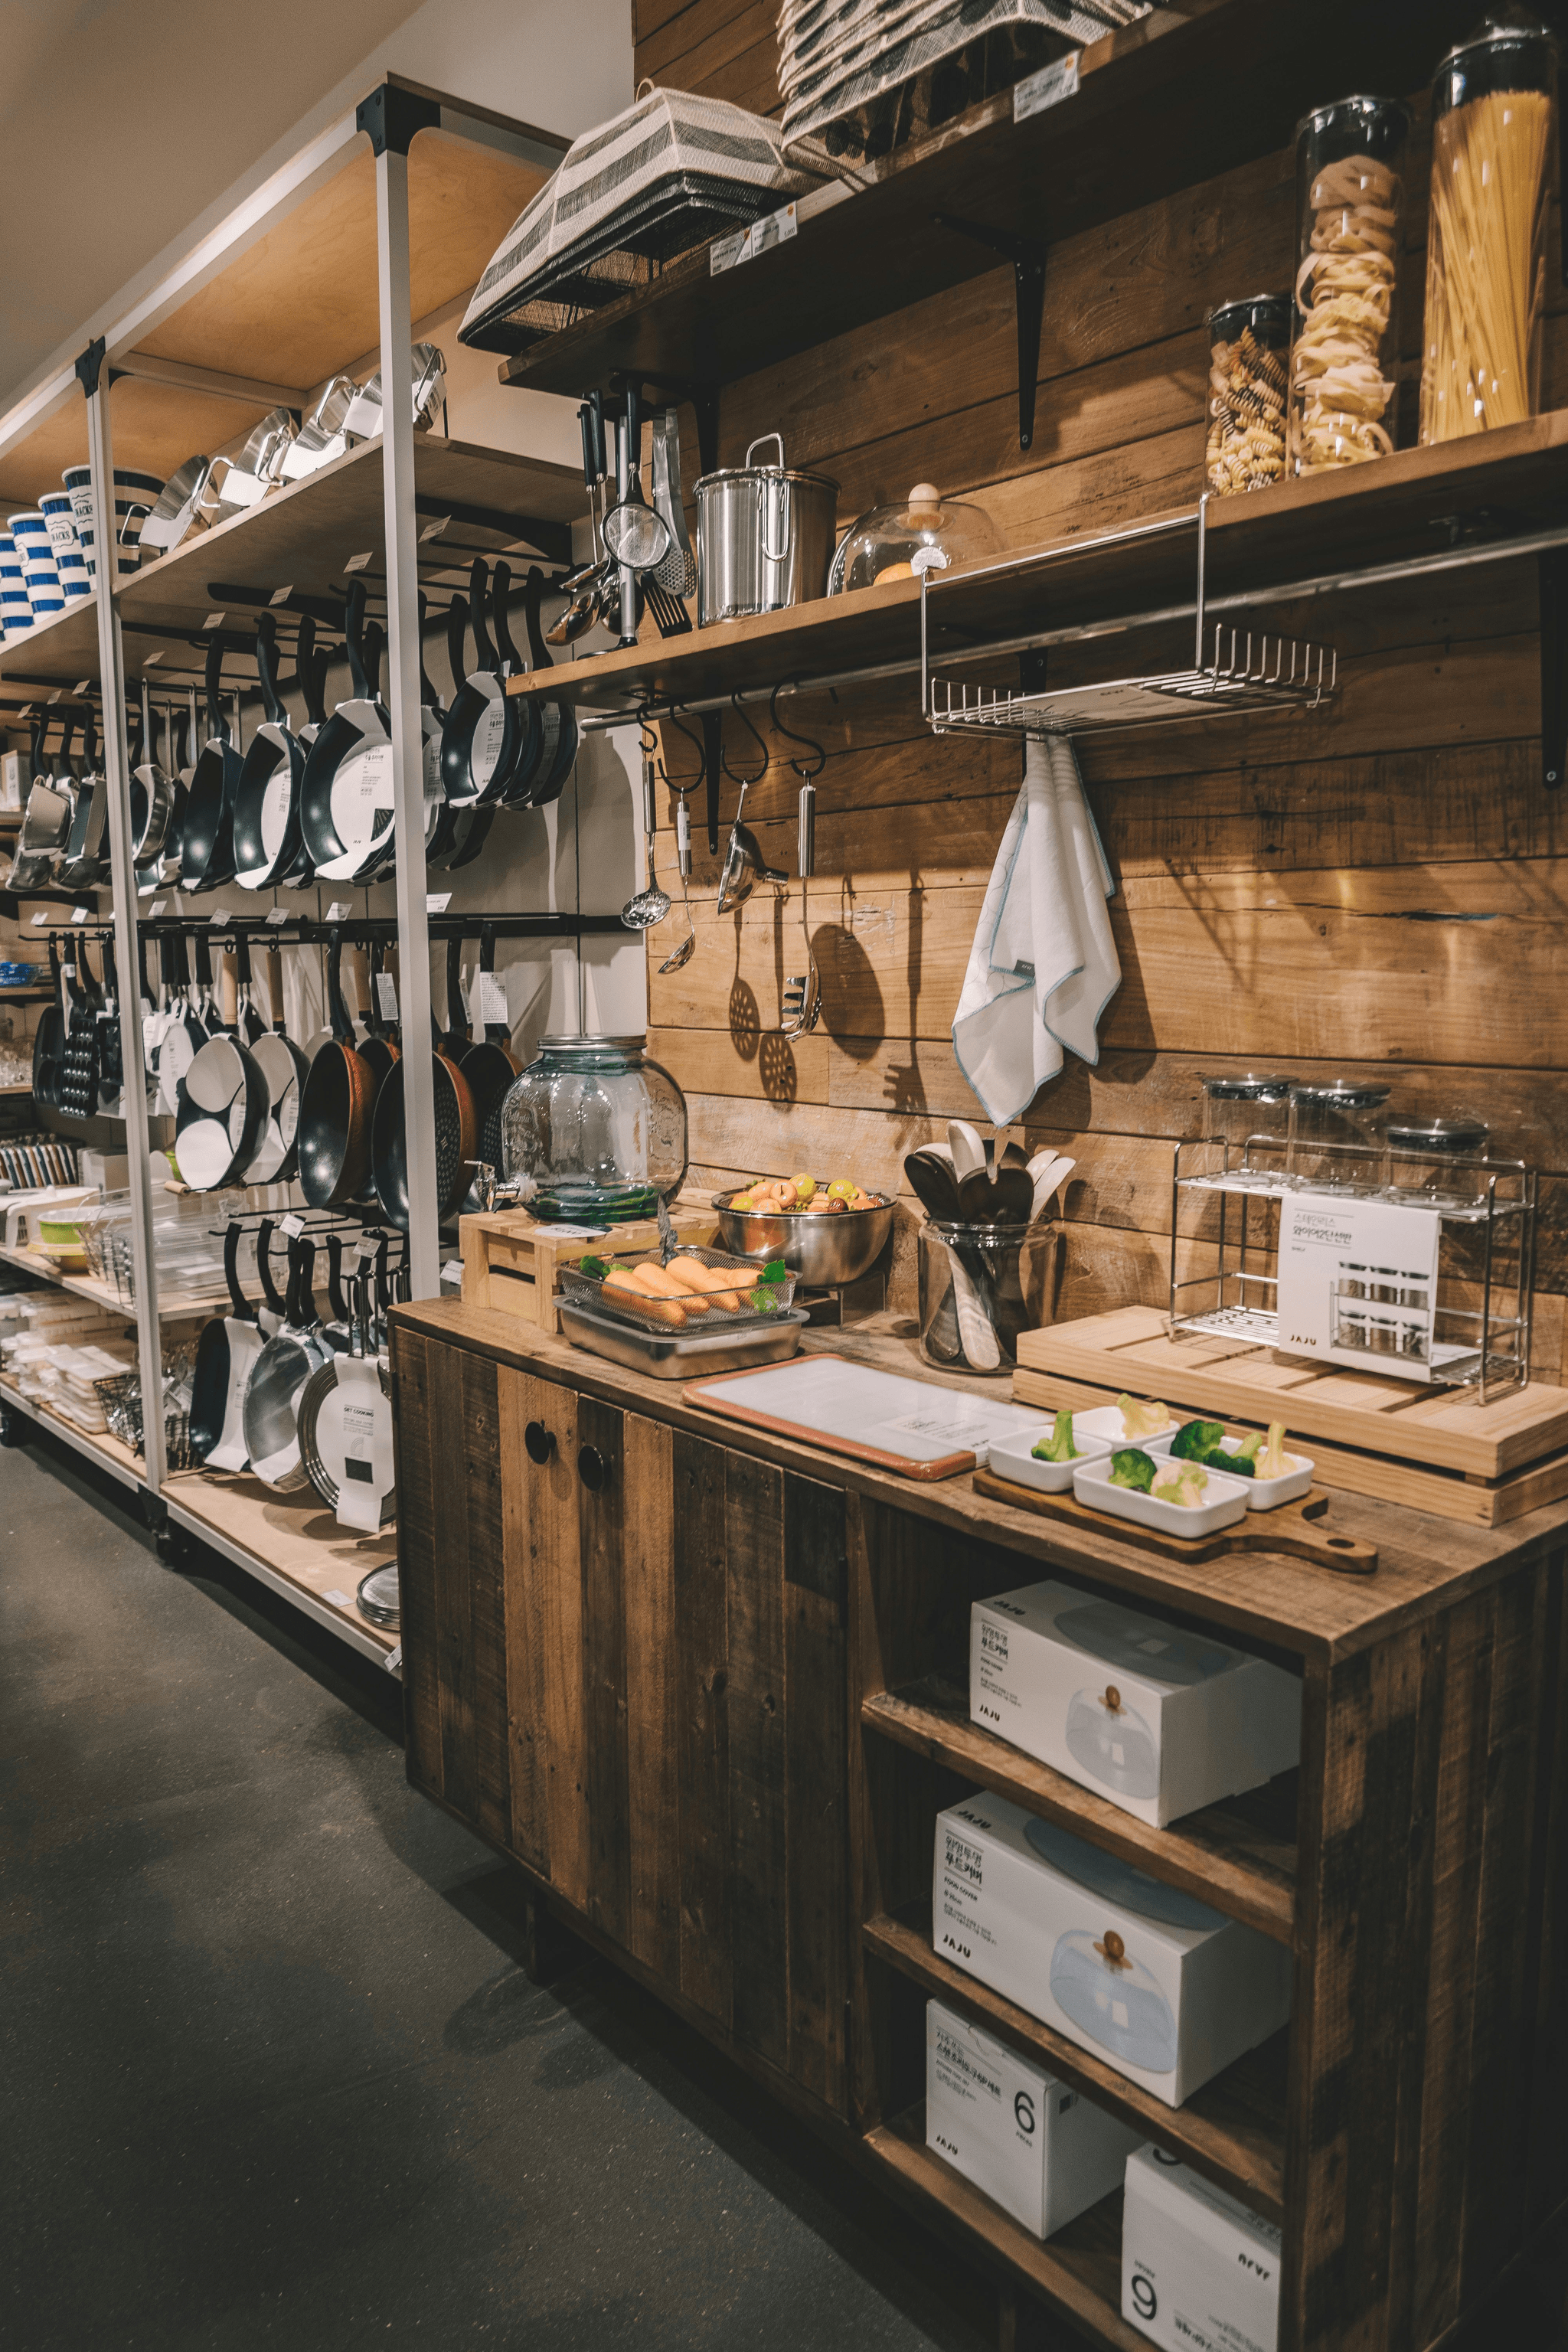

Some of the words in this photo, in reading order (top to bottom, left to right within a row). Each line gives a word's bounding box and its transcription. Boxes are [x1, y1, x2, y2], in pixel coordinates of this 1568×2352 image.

[1290, 1334, 1316, 1345] JAJU
[980, 1704, 1001, 1722] JAJU
[957, 1811, 991, 1828] JAJU
[942, 1933, 971, 1958] JAJU
[1014, 2090, 1035, 2134] 6
[936, 2134, 958, 2155] JAJU
